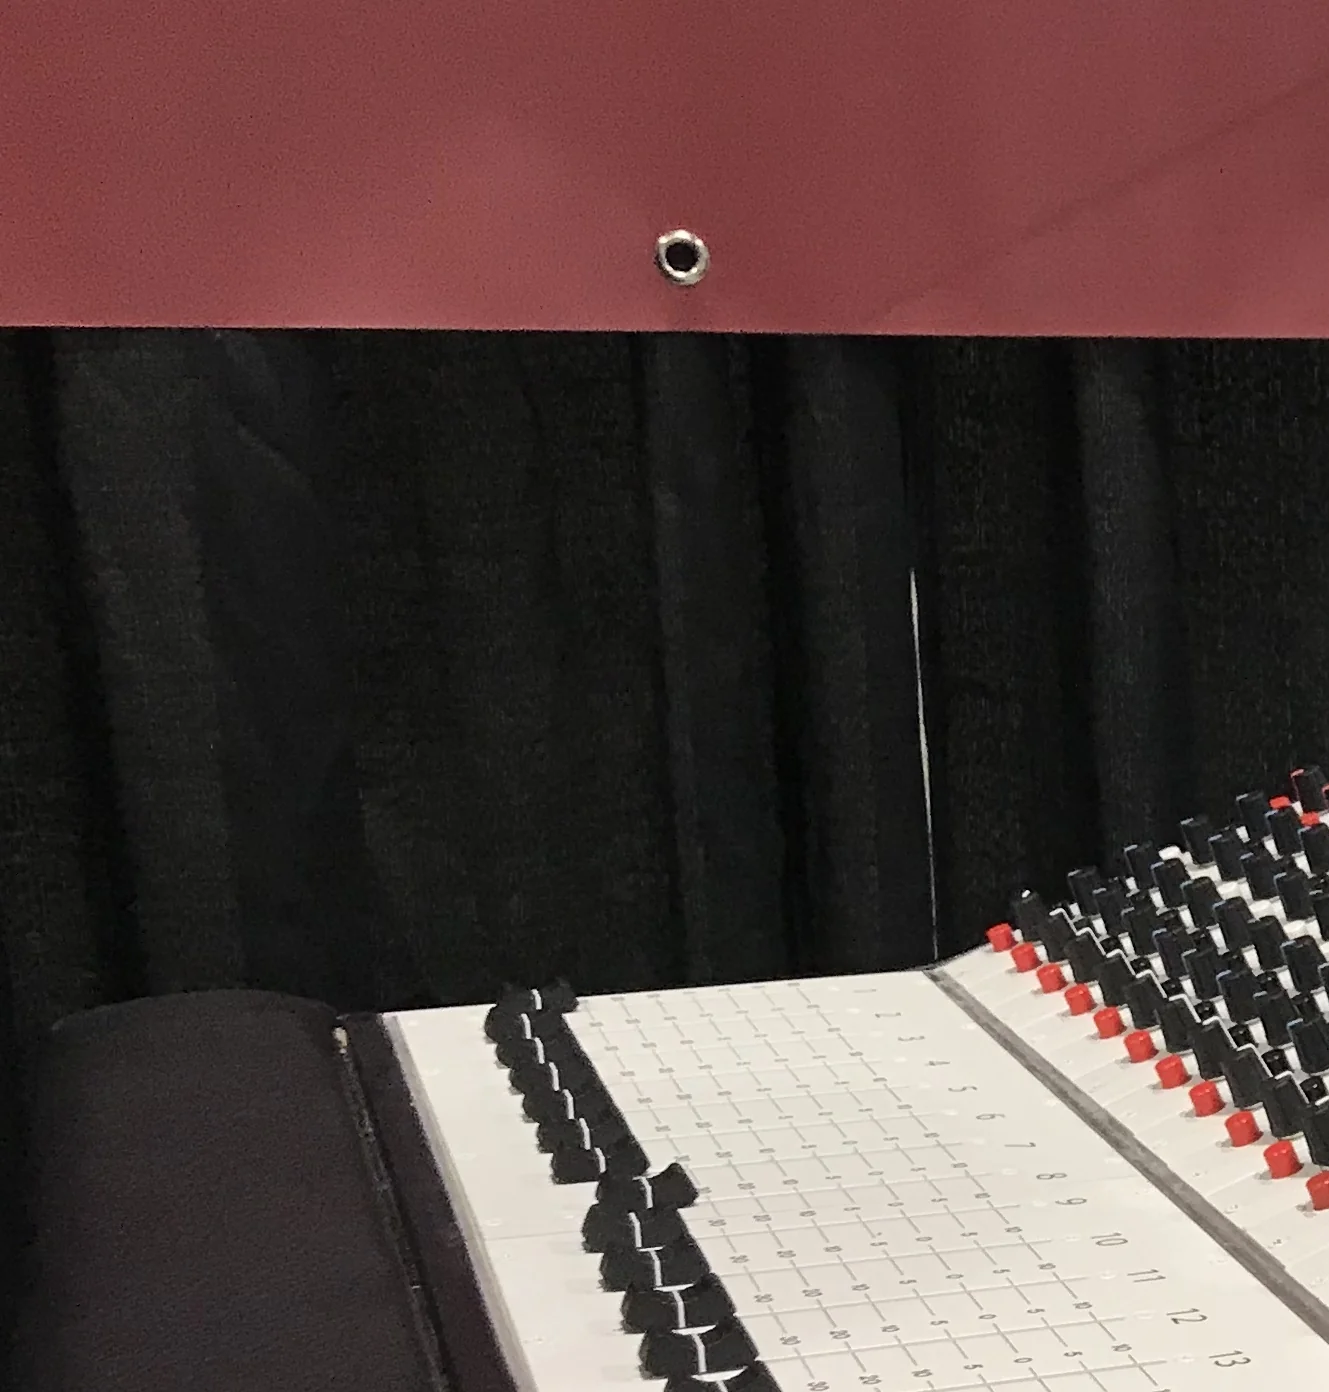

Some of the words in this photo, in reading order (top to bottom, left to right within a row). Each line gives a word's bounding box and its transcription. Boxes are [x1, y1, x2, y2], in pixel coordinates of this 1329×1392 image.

[976, 1112, 1006, 1121] 6
[1036, 1172, 1068, 1180] 8
[1055, 1197, 1088, 1206] 9
[1091, 1232, 1129, 1247] 10
[1127, 1268, 1166, 1283] 11
[1166, 1307, 1208, 1325] 12
[1208, 1350, 1252, 1368] 13
